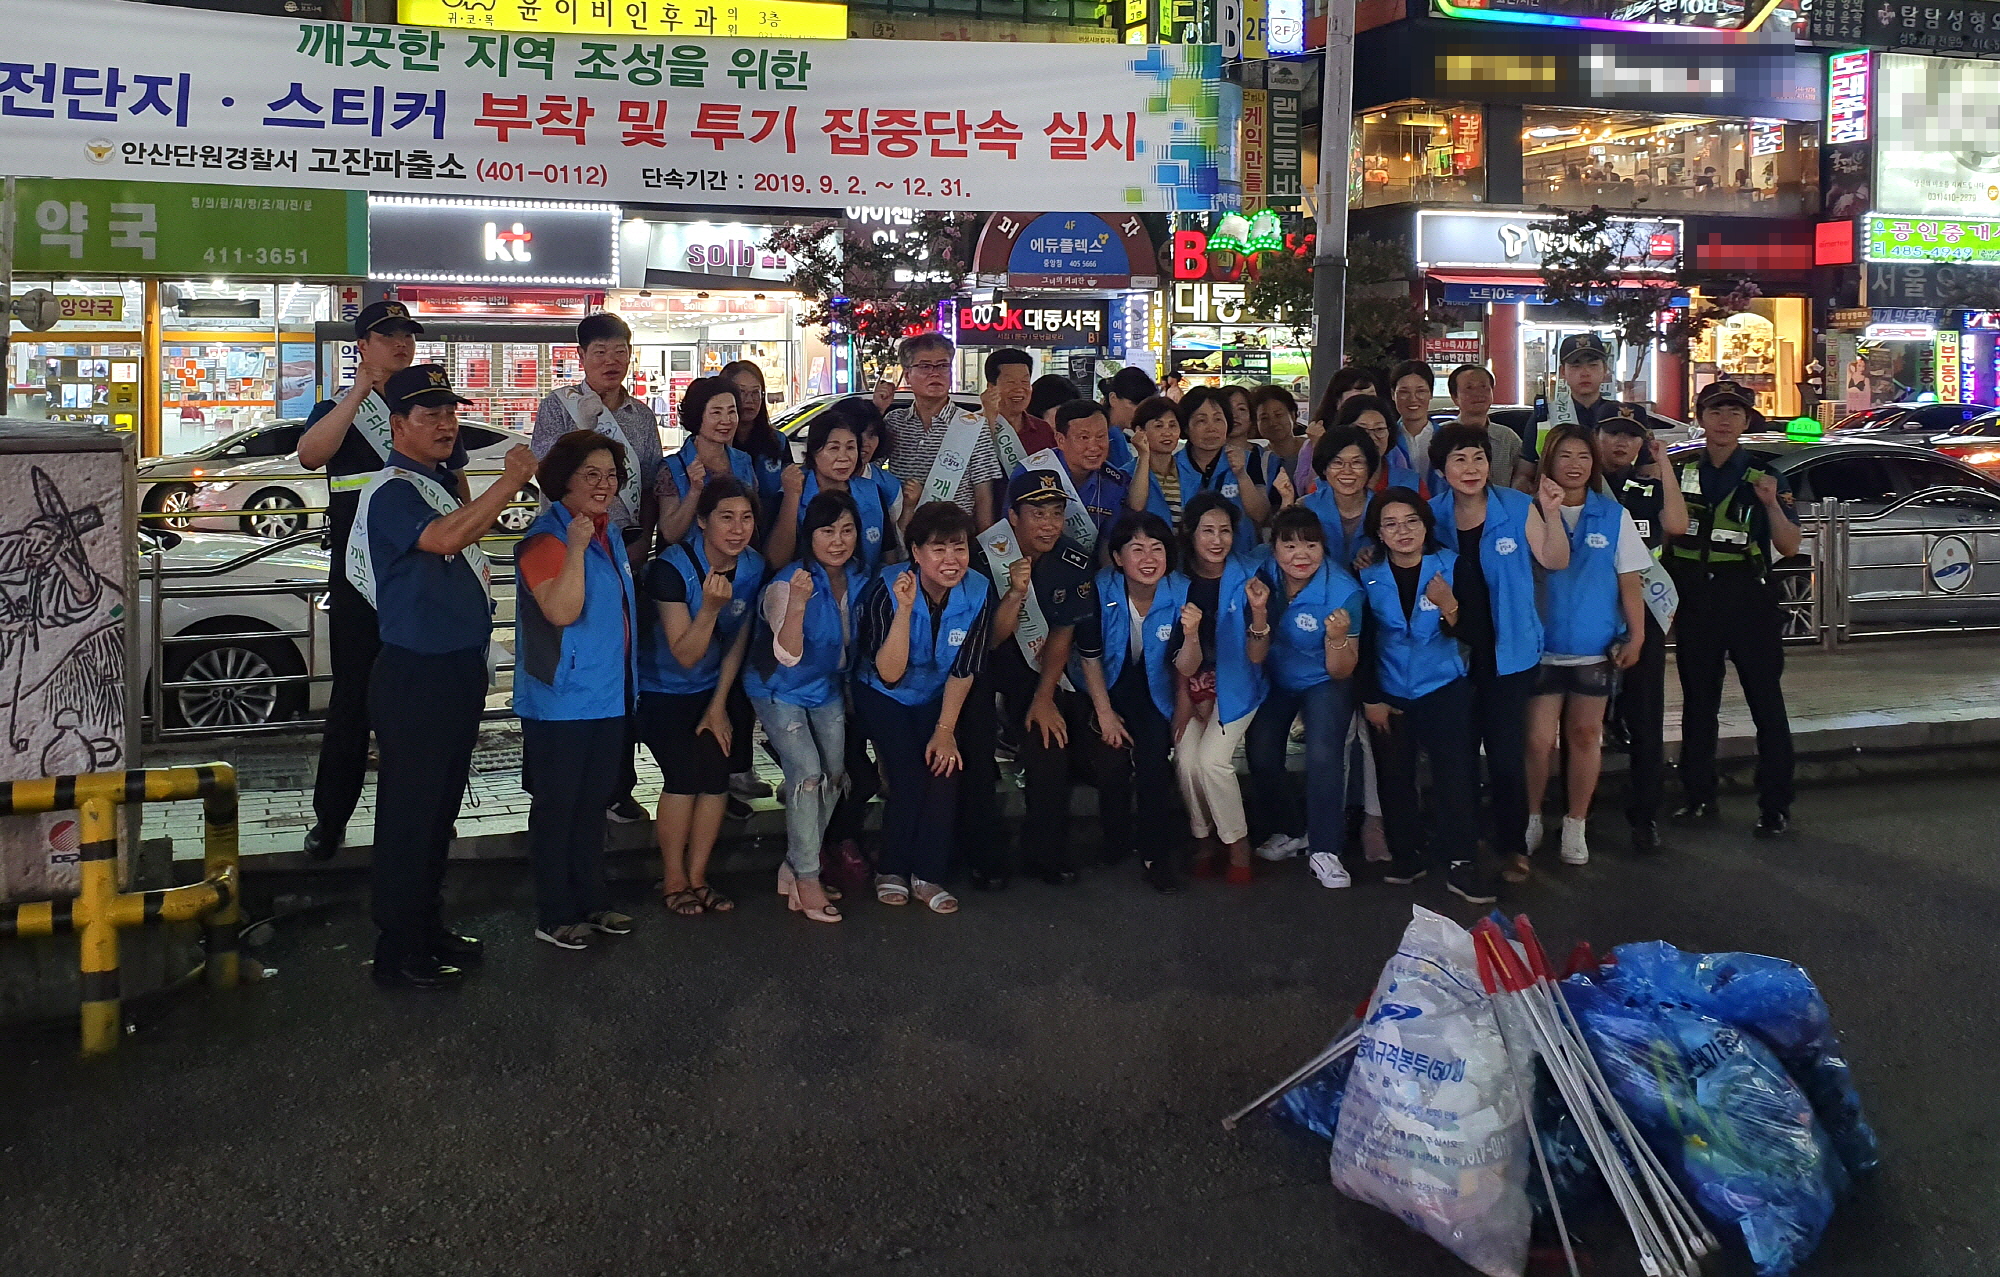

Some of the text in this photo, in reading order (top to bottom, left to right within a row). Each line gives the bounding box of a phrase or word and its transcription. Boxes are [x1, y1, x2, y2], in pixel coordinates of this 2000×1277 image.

[518, 0, 717, 35] 윤이비인후과
[759, 11, 782, 28] 3층
[1246, 17, 1266, 41] 2F
[1274, 26, 1291, 35] 2F
[296, 23, 811, 91] 깨끗한 지역 조성을 위한
[1832, 57, 1867, 141] 노래주점
[0, 62, 190, 127] 전단지
[263, 81, 447, 140] 스티커
[474, 92, 594, 145] 부착
[617, 98, 666, 149] 및
[690, 100, 797, 155] 투기
[821, 108, 1024, 160] 집중단속
[1043, 111, 1137, 161] 실시
[121, 141, 298, 173] 안산단원경찰서
[308, 148, 467, 182] 고잔파출소
[475, 159, 607, 186] (401-0112)
[641, 167, 728, 192] 단속기간
[754, 172, 811, 194] 2019.
[820, 174, 842, 194] 9.
[845, 174, 868, 195] 2.
[902, 177, 932, 197] 12.
[940, 178, 971, 199] 31.
[1244, 106, 1263, 211] 케익만들기
[35, 200, 157, 260] 약국
[997, 216, 1020, 240] 보
[1064, 220, 1076, 230] 4F
[1121, 216, 1141, 238] 자
[484, 222, 532, 262] kt
[687, 239, 755, 267] solb
[1030, 237, 1104, 254] 에듀플렉스
[1891, 246, 1973, 258] 485-4949
[203, 247, 308, 265] 411-3651
[1469, 288, 1514, 300] 노트10도
[1024, 308, 1101, 331] 대동서적
[1940, 333, 1957, 343] 우리
[1941, 346, 1957, 402] 부동산
